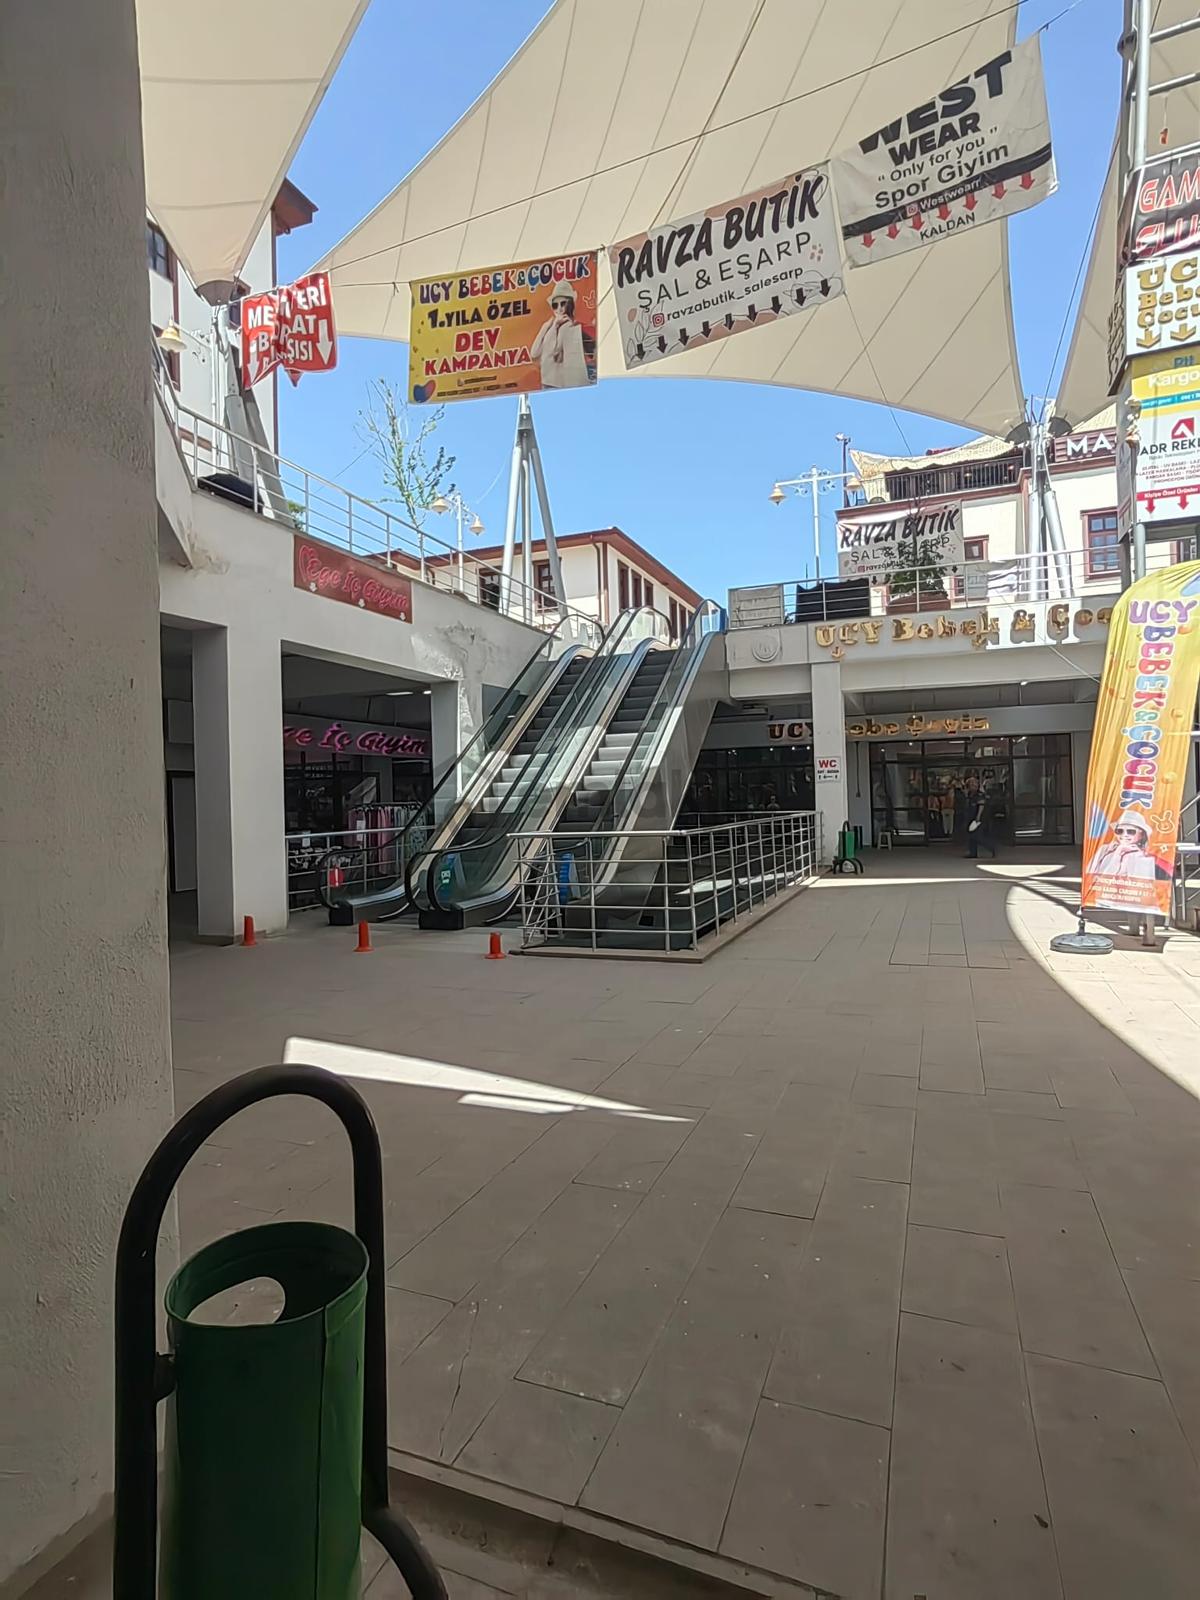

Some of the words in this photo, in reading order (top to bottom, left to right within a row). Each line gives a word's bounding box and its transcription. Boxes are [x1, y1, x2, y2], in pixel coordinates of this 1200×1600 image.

[888, 112, 981, 167] WEAR
[890, 160, 925, 183] Only
[929, 150, 952, 167] for
[955, 136, 985, 157] you
[875, 176, 932, 209] Spor
[937, 144, 1009, 184] Giyim
[617, 217, 713, 289] RAVZA
[723, 173, 824, 249] BUTİK
[920, 212, 976, 240] KALDAN
[637, 278, 690, 313] ŞAL
[695, 268, 712, 290] &
[718, 231, 812, 280] EŞARP
[419, 281, 453, 304] UCY
[666, 267, 804, 322] ravzabutik_salesarp
[428, 307, 482, 329] 1.YILA
[487, 299, 531, 321] ÖZEL
[455, 327, 500, 353] DEV
[424, 347, 532, 376] KAMPANYA
[1066, 432, 1117, 457] MA
[1140, 443, 1167, 456] ADR
[841, 520, 897, 549] RAVZA
[902, 505, 960, 539] BUTİK
[1129, 600, 1198, 624] UCY
[815, 620, 883, 647] UCY
[818, 759, 837, 769] WC
